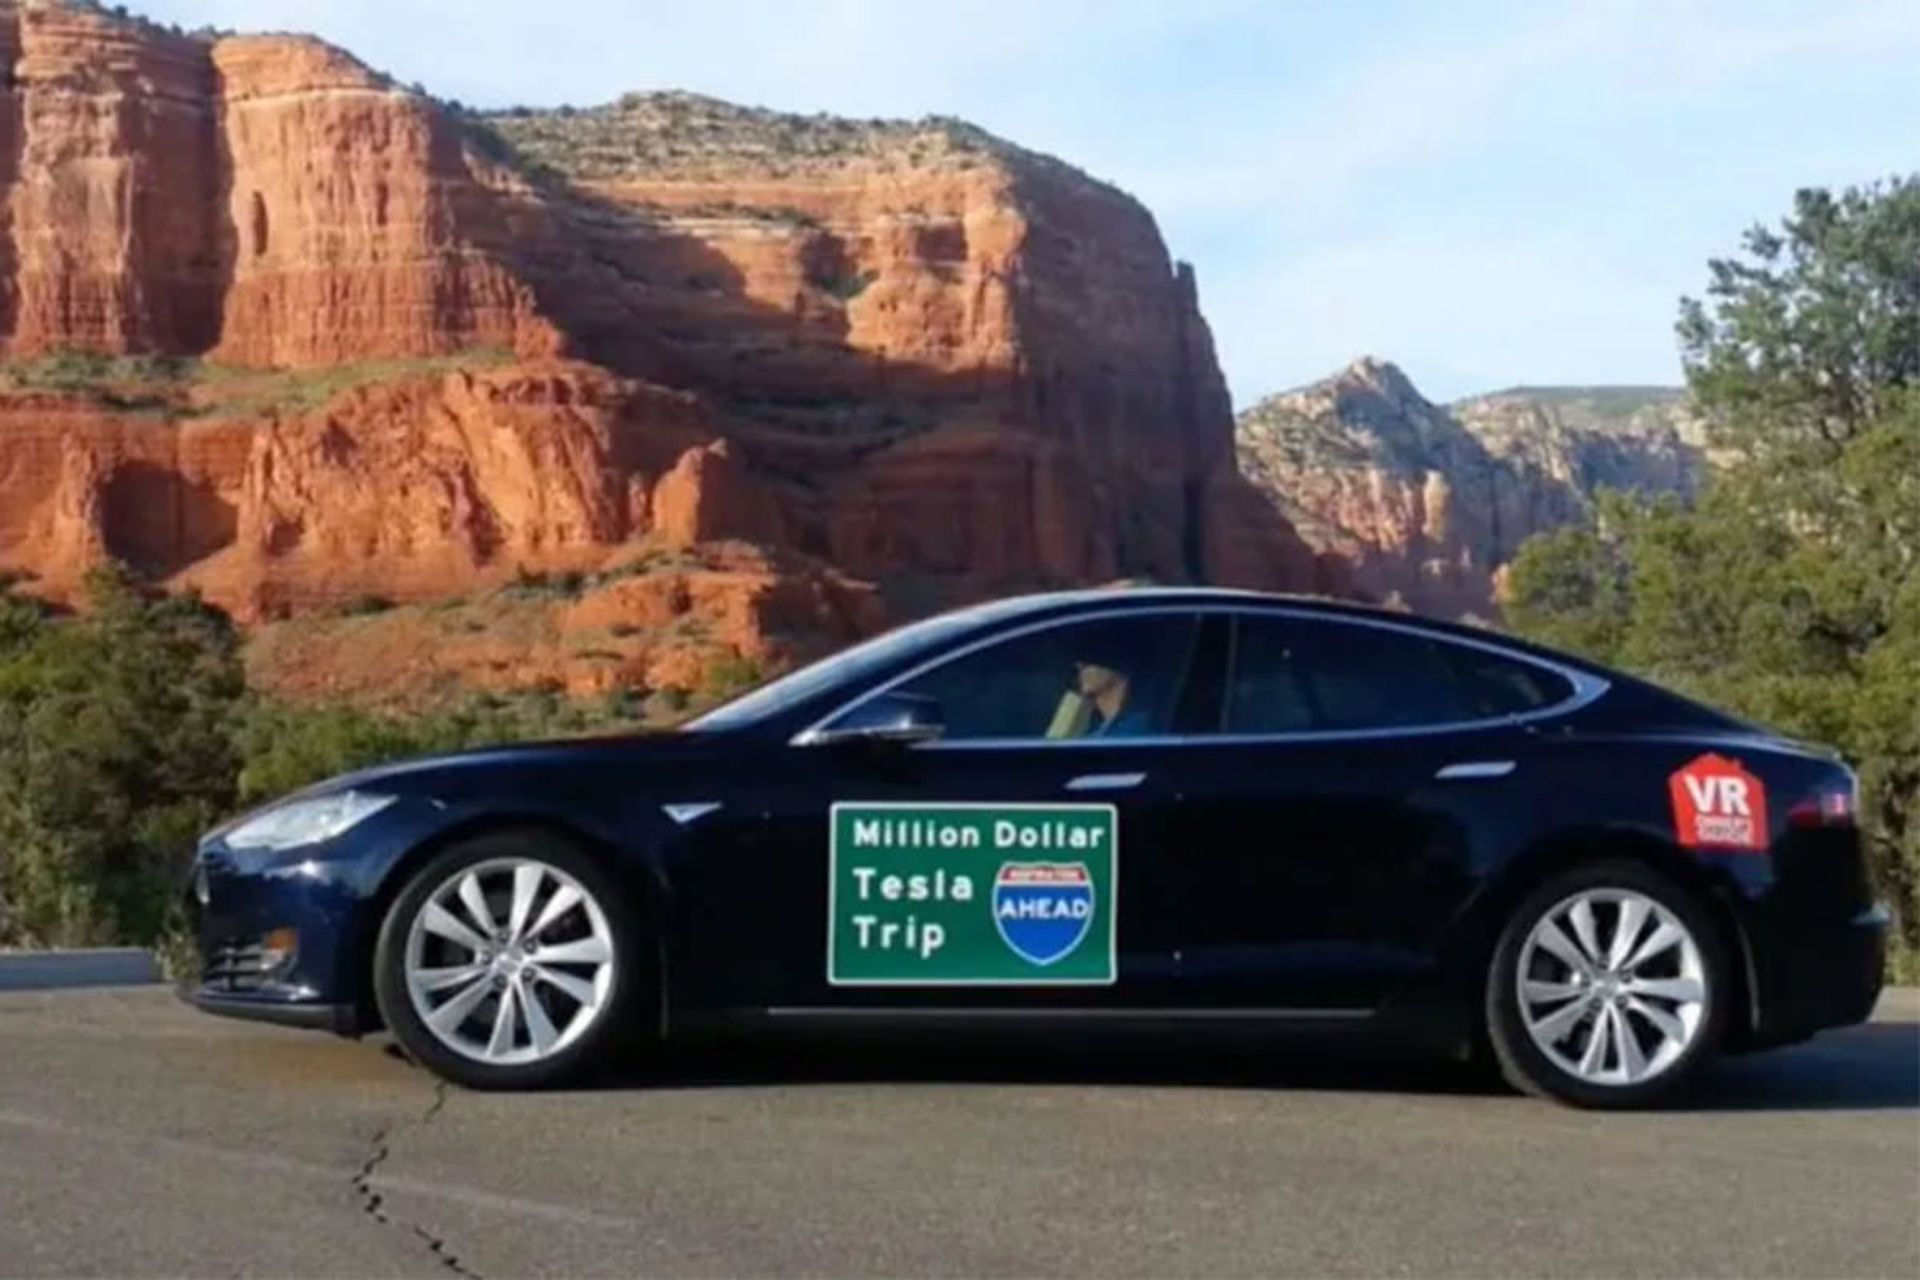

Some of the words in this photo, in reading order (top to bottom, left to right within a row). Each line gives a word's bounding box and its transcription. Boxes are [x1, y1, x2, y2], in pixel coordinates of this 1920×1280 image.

[1684, 774, 1750, 815] VR
[853, 819, 980, 848] Million
[995, 820, 1104, 848] Dollar
[852, 867, 973, 901] Tesla
[1000, 897, 1089, 919] AHEAD
[852, 915, 945, 958] Trip
